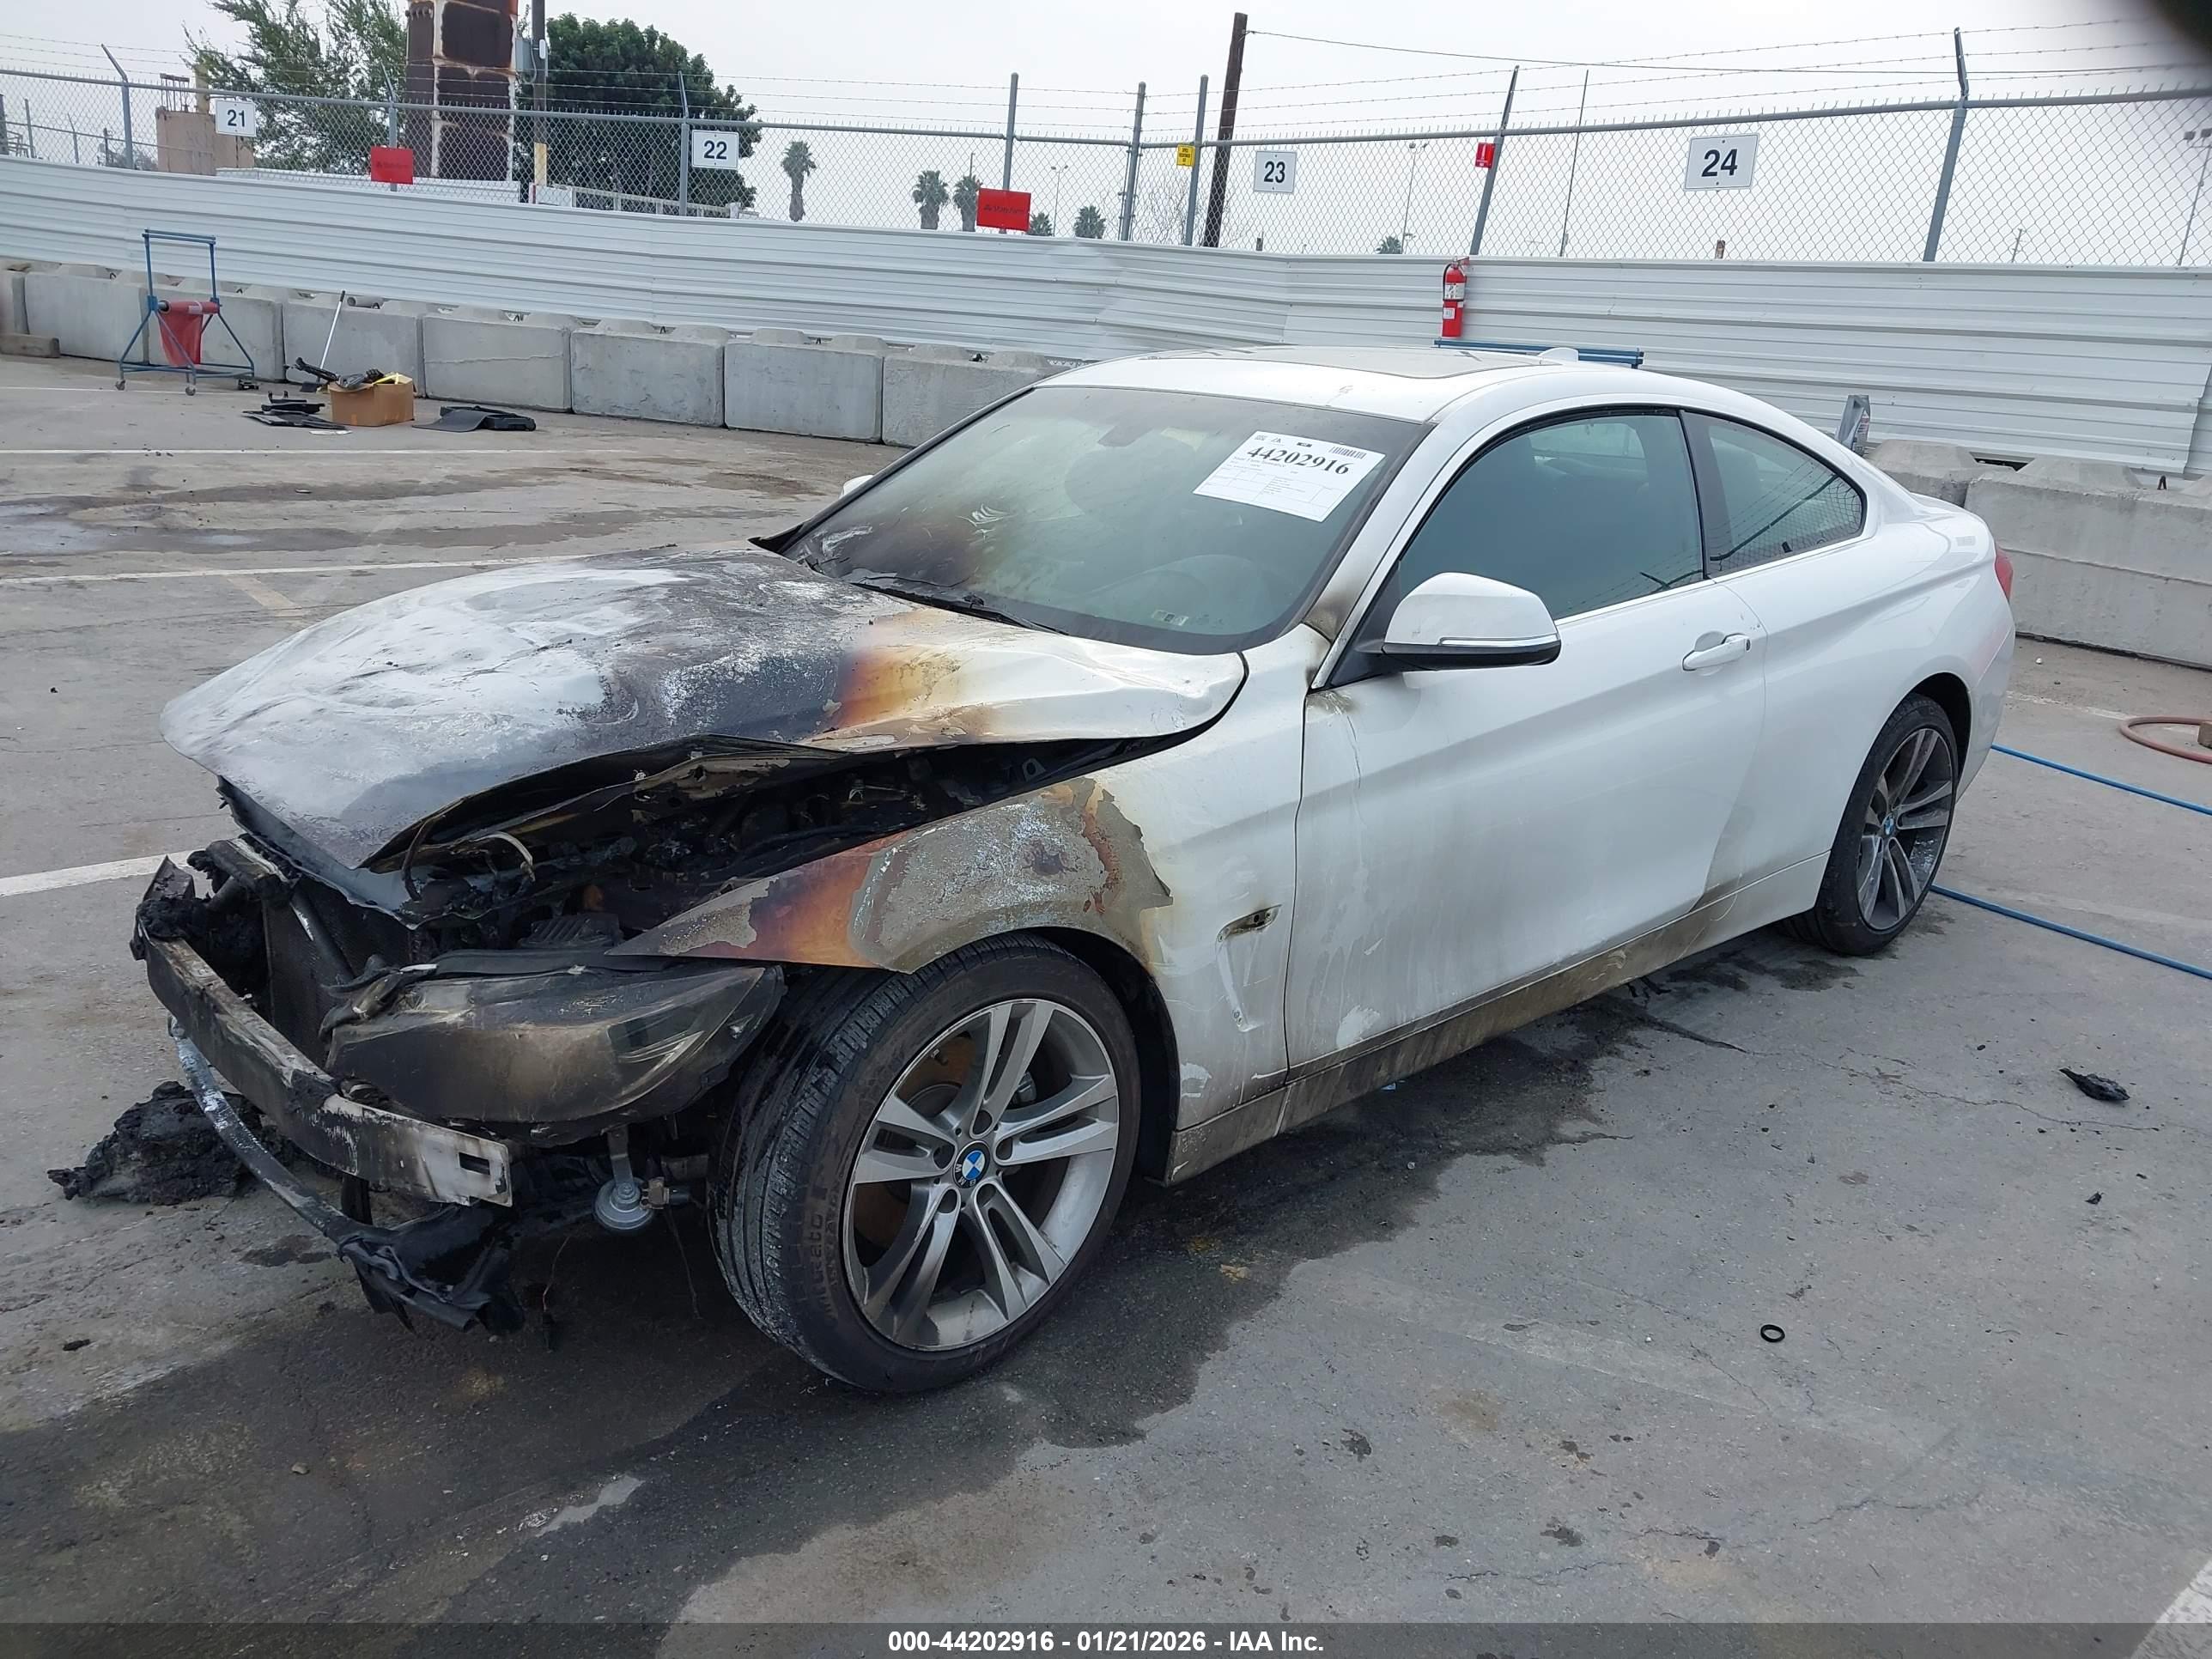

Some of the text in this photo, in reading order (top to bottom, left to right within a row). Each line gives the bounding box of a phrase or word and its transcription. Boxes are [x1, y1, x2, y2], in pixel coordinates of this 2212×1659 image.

[227, 109, 245, 127] 21
[704, 140, 727, 160] 22
[1263, 161, 1285, 183] 23
[1701, 149, 1738, 177] 24
[1247, 446, 1354, 475] 44202916
